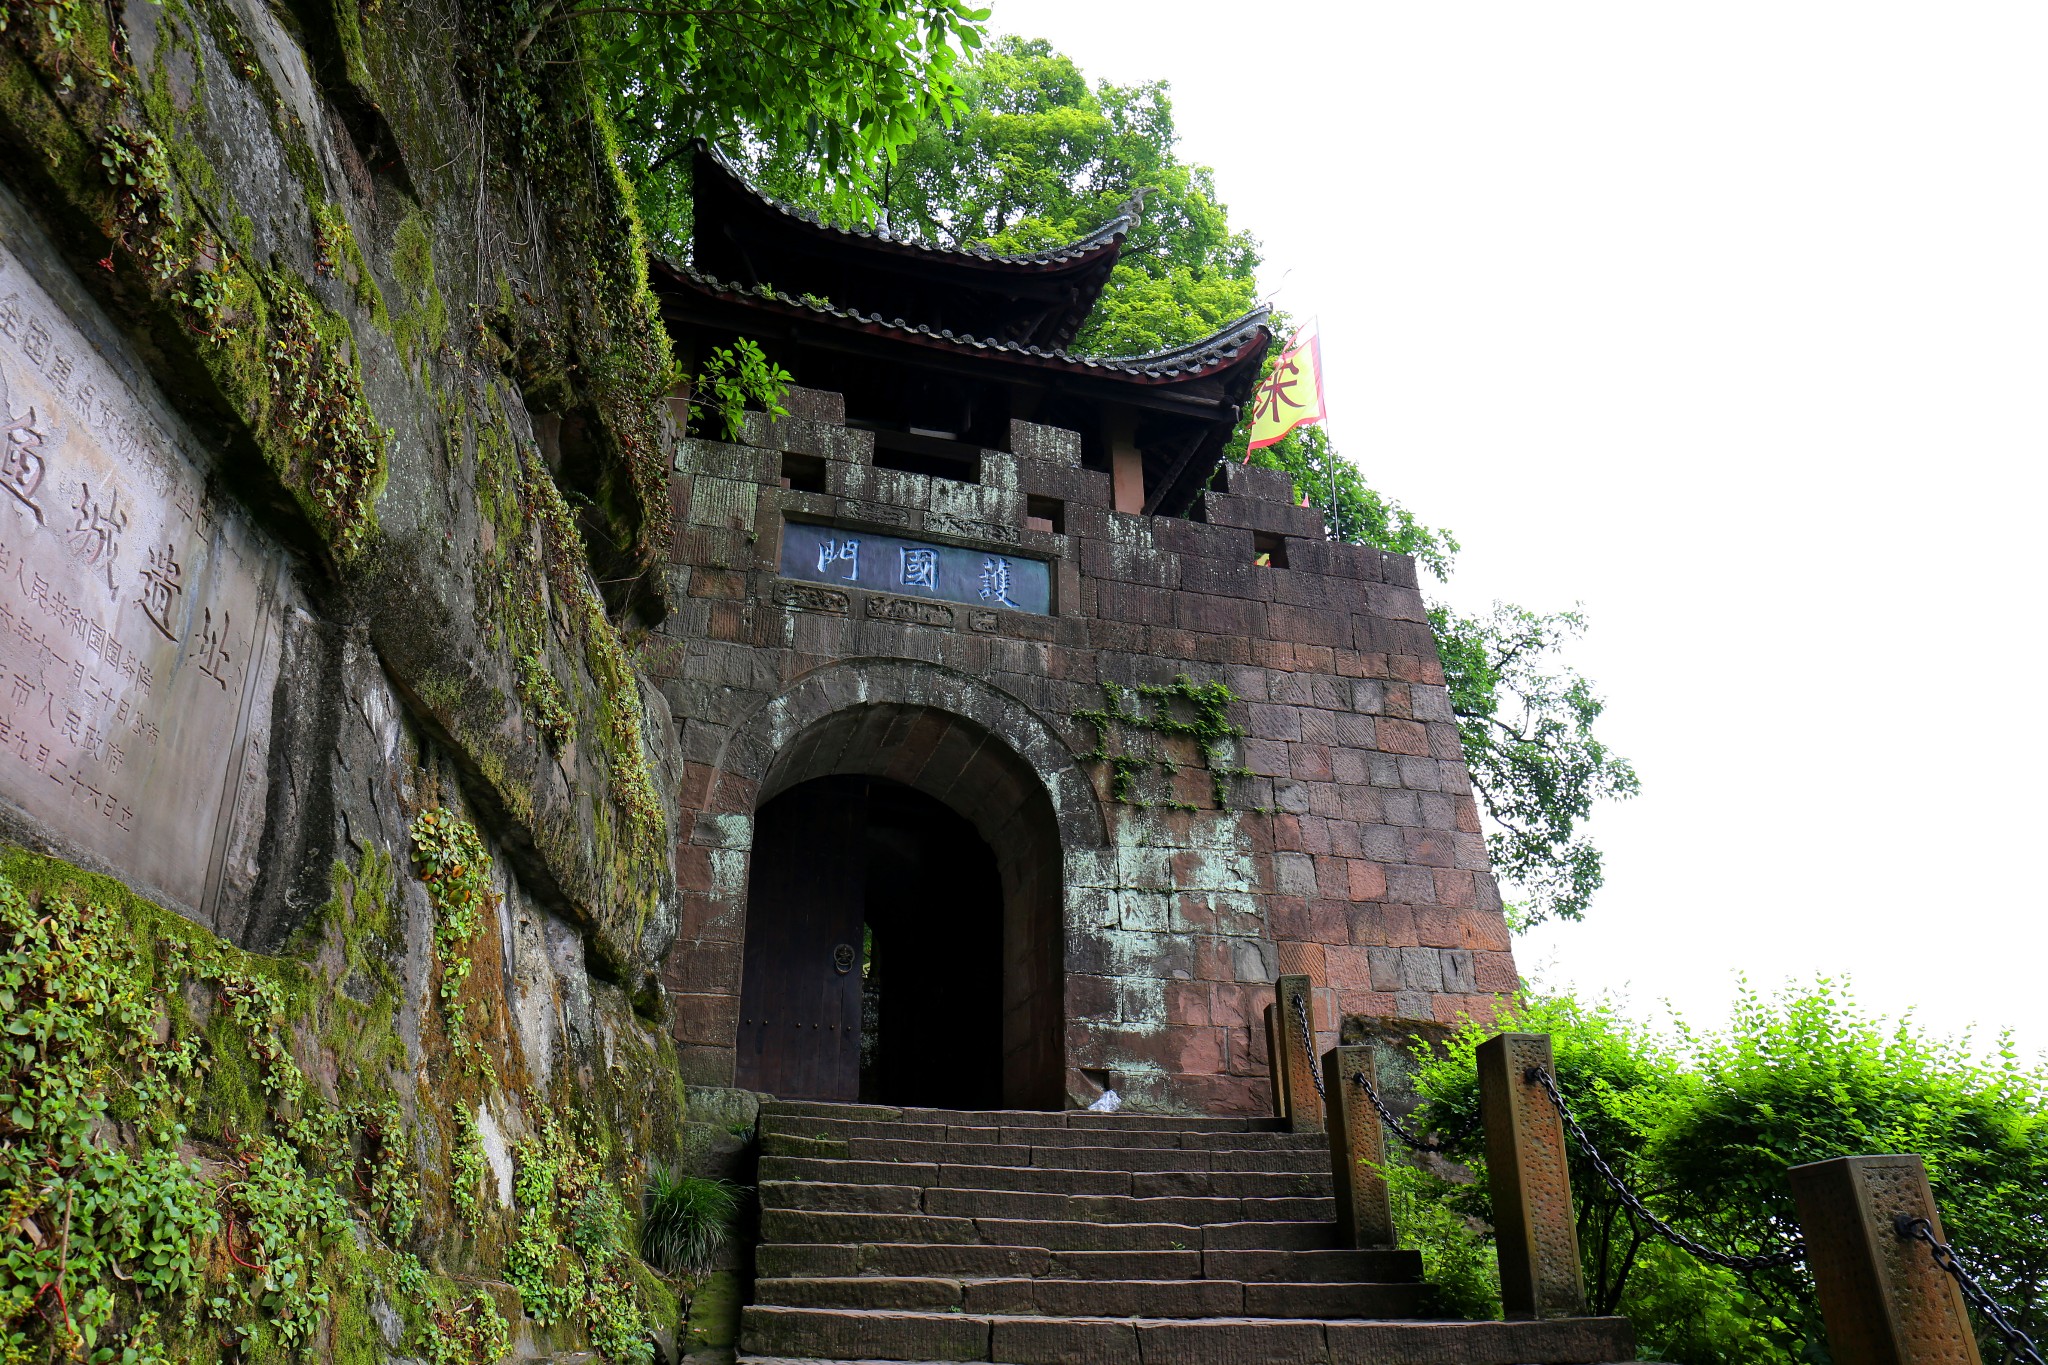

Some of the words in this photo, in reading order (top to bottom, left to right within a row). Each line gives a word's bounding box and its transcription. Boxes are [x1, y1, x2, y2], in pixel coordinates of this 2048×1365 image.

[0, 292, 212, 546] 全国重点文物保单位
[1256, 359, 1306, 423] 宋
[0, 662, 125, 775] 市人民政府
